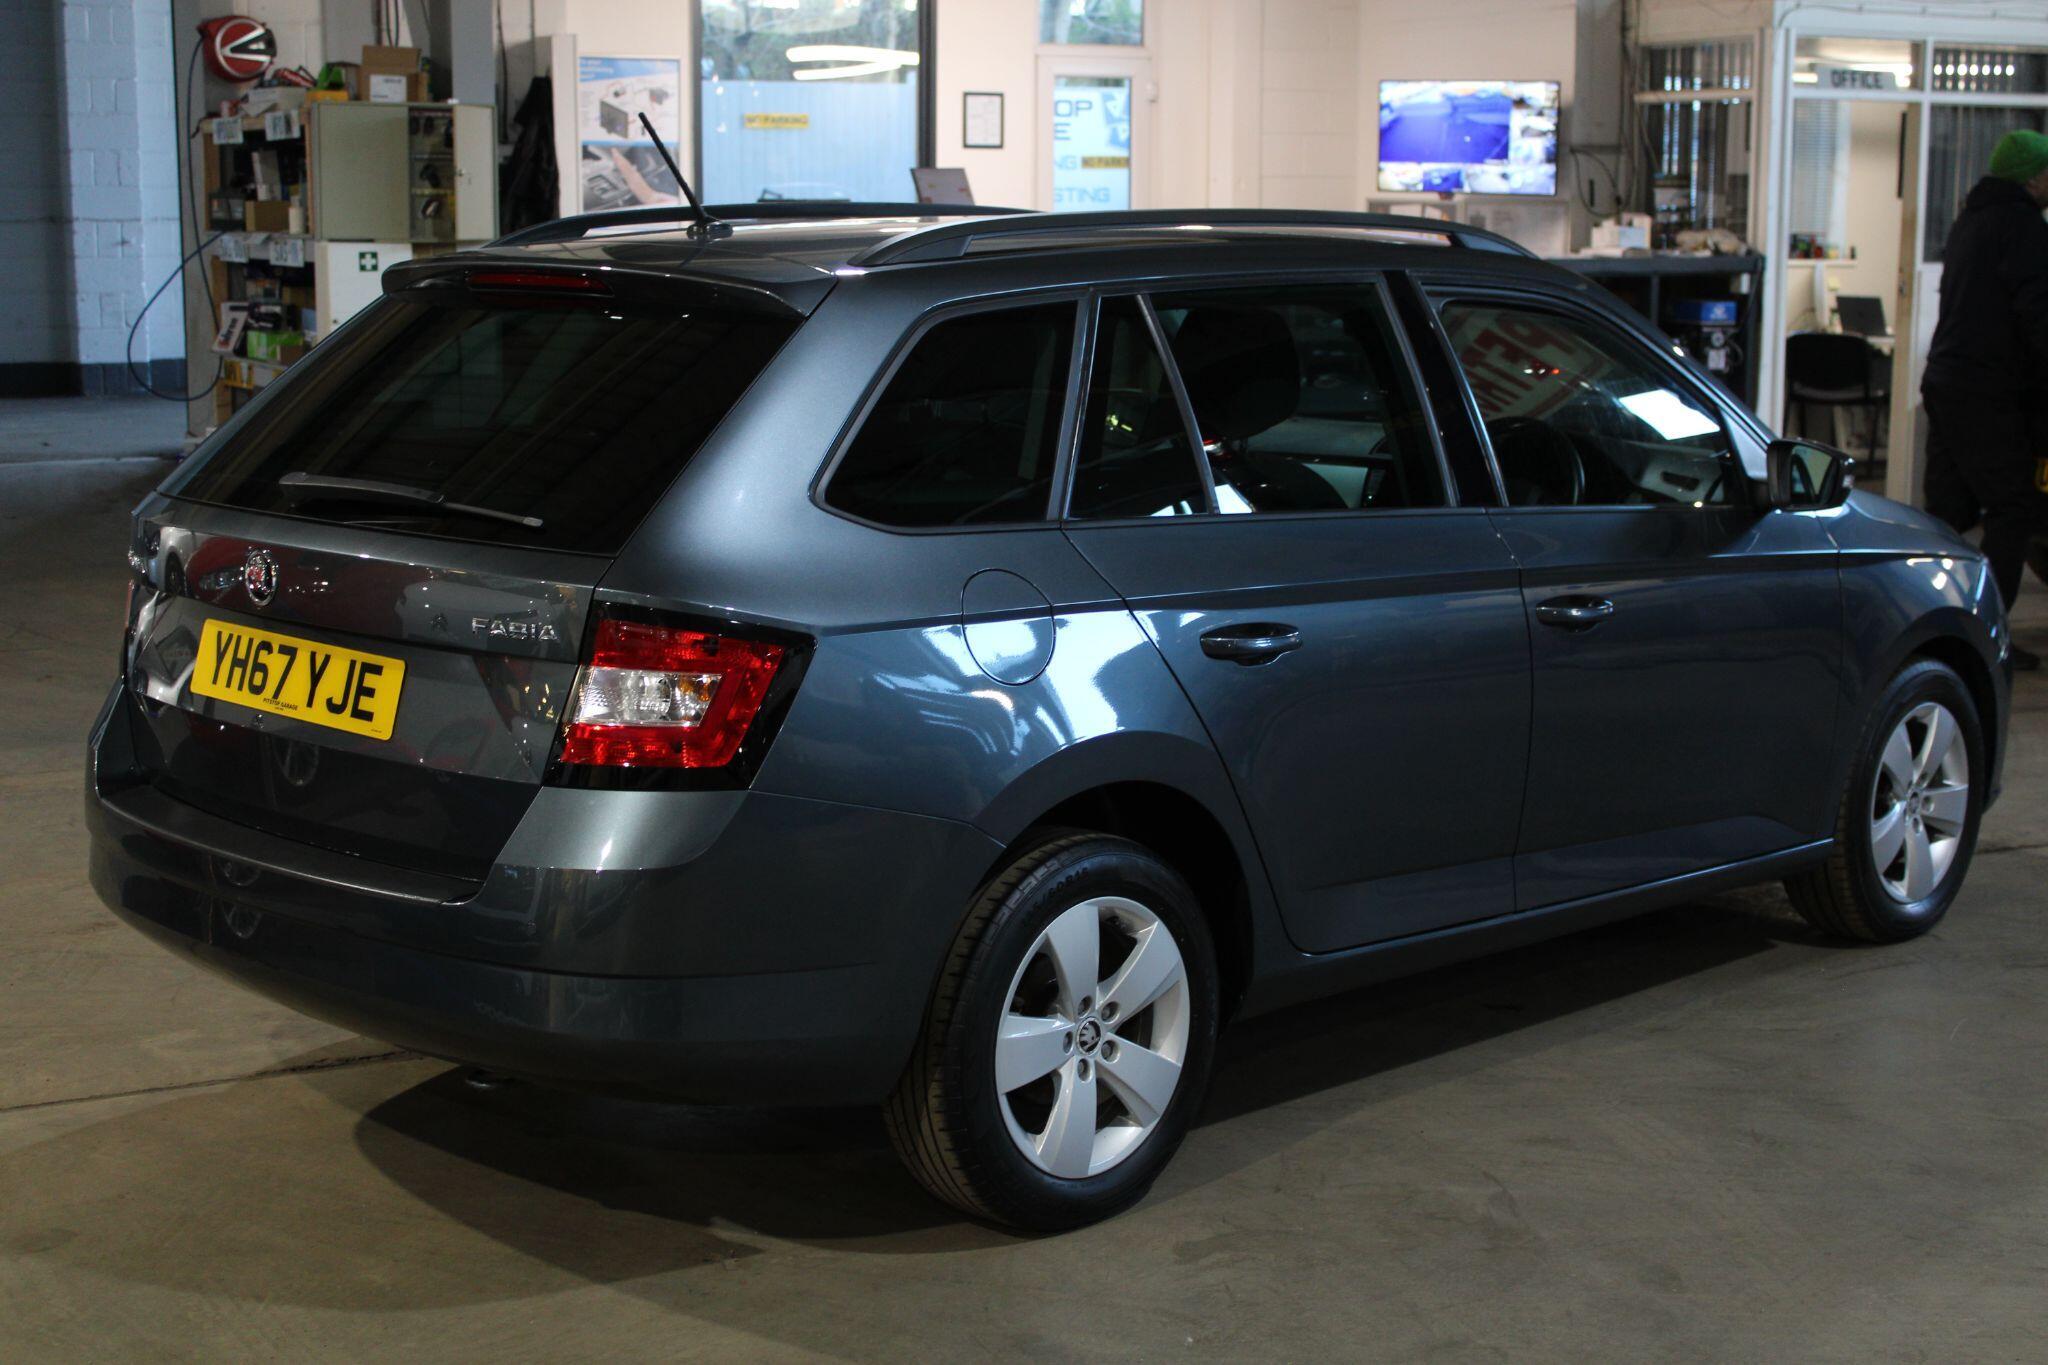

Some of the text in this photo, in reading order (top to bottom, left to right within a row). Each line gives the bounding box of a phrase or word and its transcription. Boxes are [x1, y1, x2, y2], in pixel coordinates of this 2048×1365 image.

[1831, 70, 1883, 89] OFFICE
[471, 617, 559, 641] FABIA
[211, 630, 384, 722] YH67 YJE
